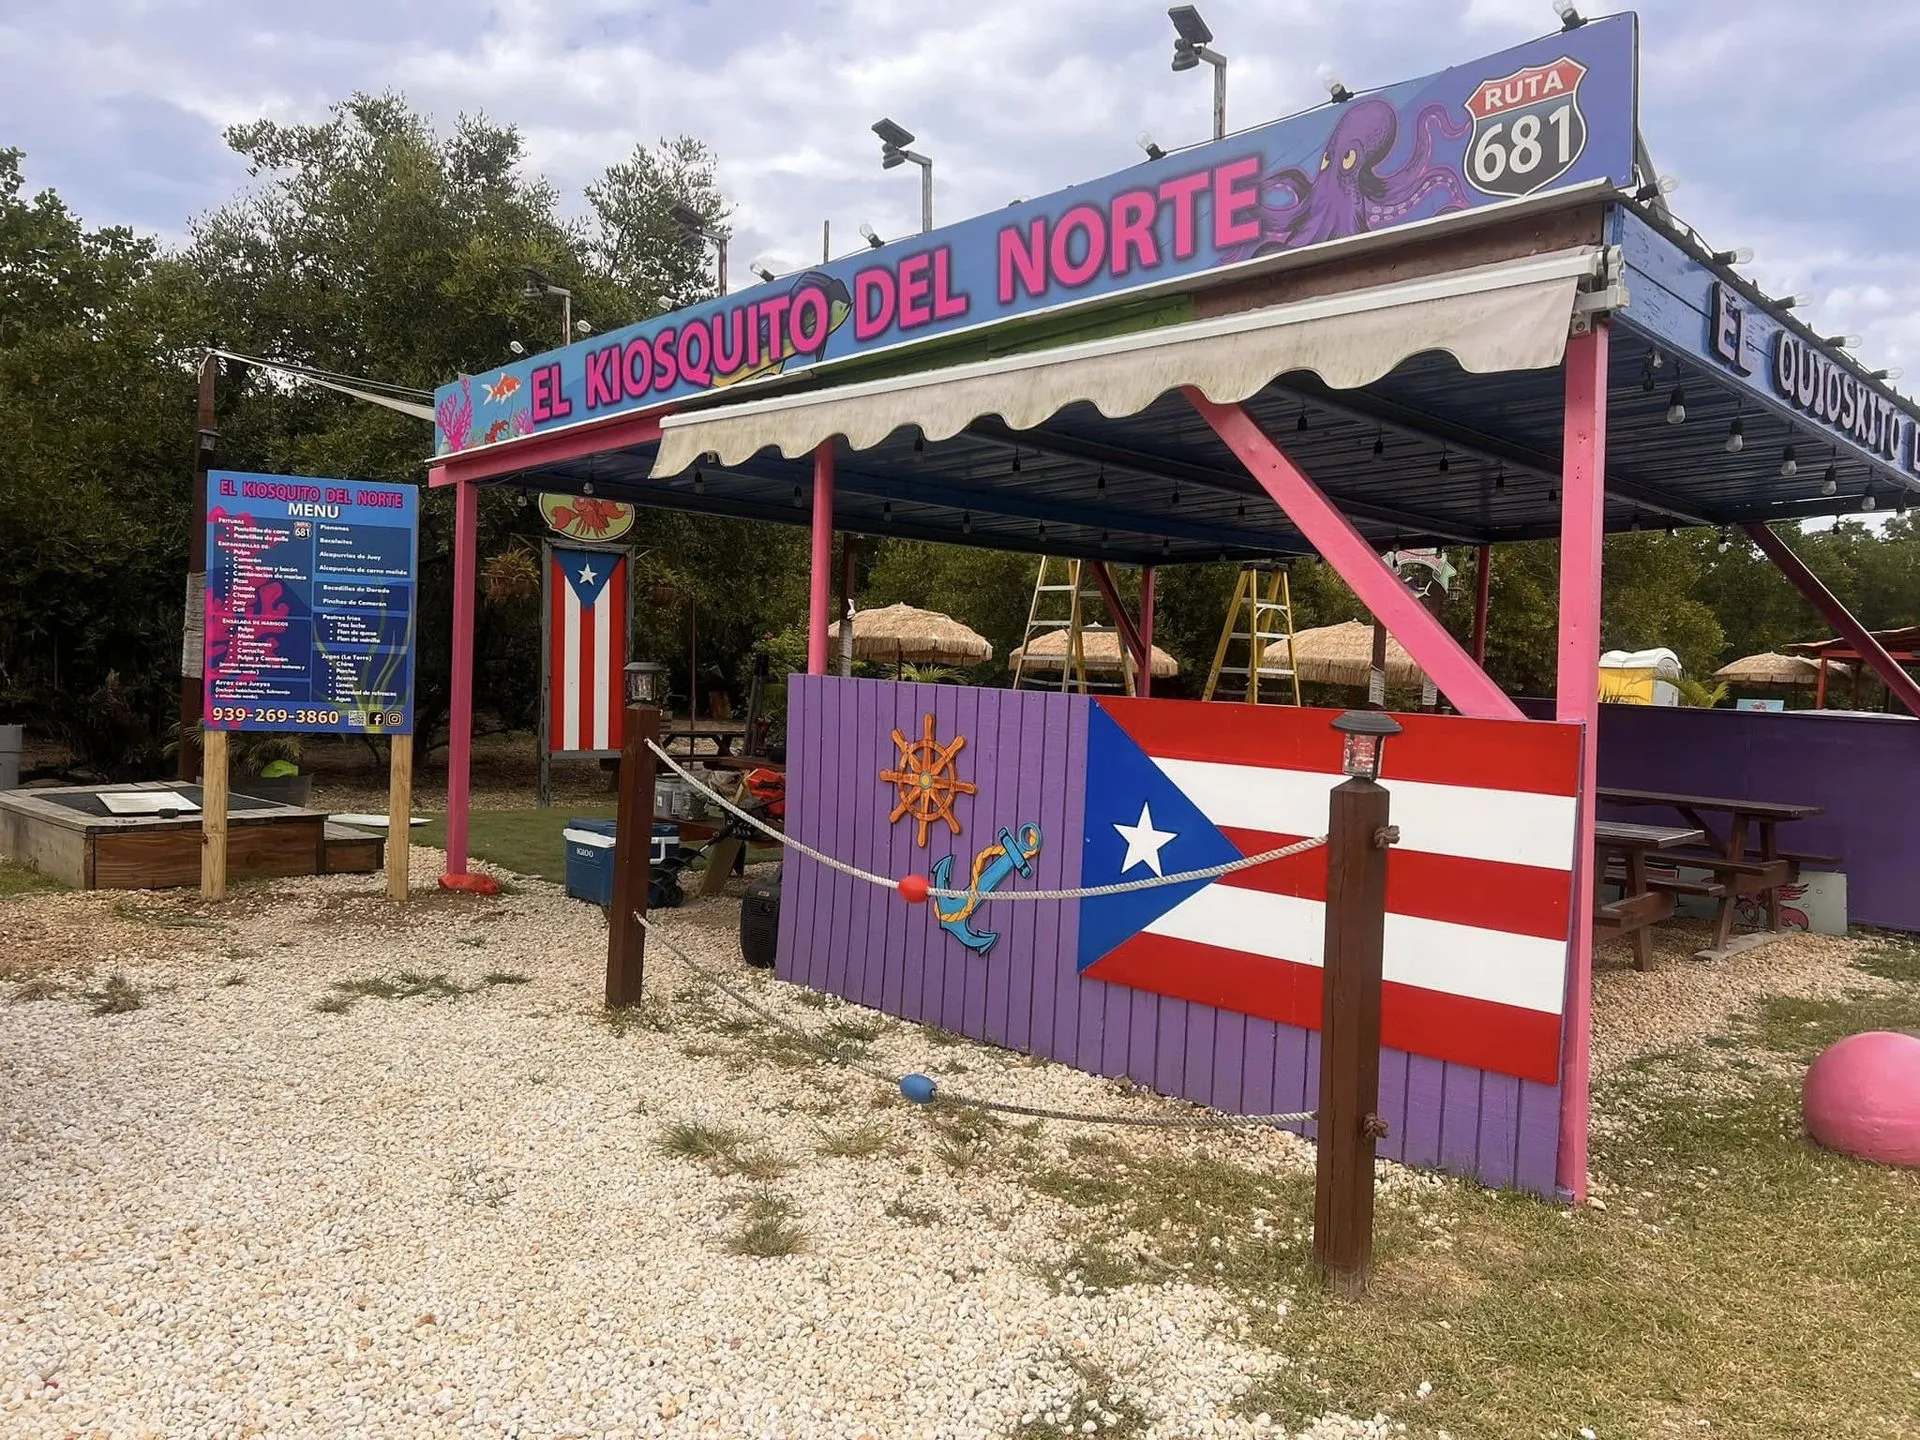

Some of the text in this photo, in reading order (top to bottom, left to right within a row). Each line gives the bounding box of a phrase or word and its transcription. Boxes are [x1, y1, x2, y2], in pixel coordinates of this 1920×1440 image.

[1485, 70, 1563, 110] RUTA
[1474, 104, 1570, 182] 681
[531, 156, 1262, 422] EL KIOSQUITO DEL NORTE
[1712, 281, 1753, 376] EL
[1775, 330, 1901, 458] QUIOSKITO
[220, 479, 404, 508] EL KIOSQUITO DEL NORTE
[288, 502, 340, 518] MENU
[295, 528, 310, 537] 681
[212, 706, 339, 724] 939-269-3860
[576, 848, 594, 858] IGLOO
